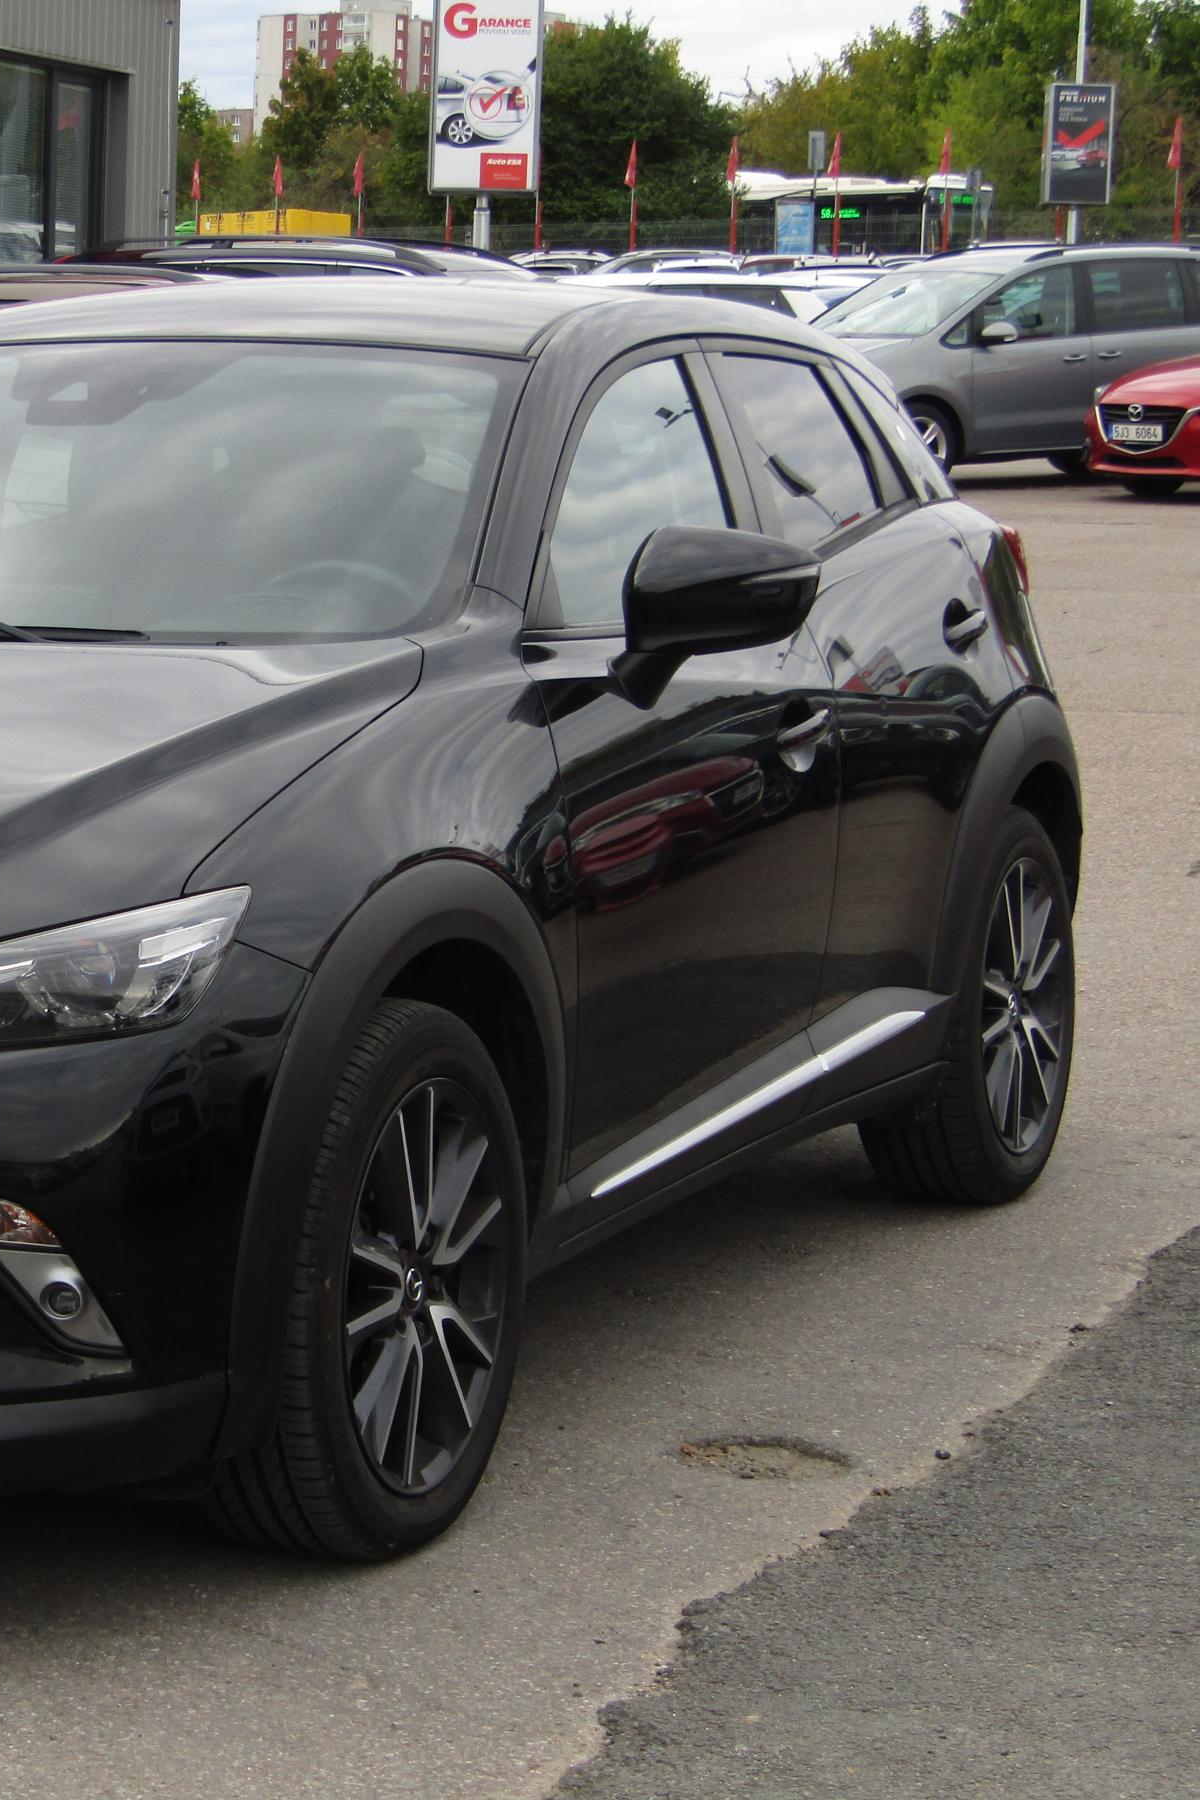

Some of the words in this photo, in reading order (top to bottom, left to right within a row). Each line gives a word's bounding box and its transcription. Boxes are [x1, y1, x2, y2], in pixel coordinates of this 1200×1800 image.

[444, 2, 531, 39] GARANCE
[487, 158, 506, 166] Auto
[1114, 426, 1129, 438] 5J3
